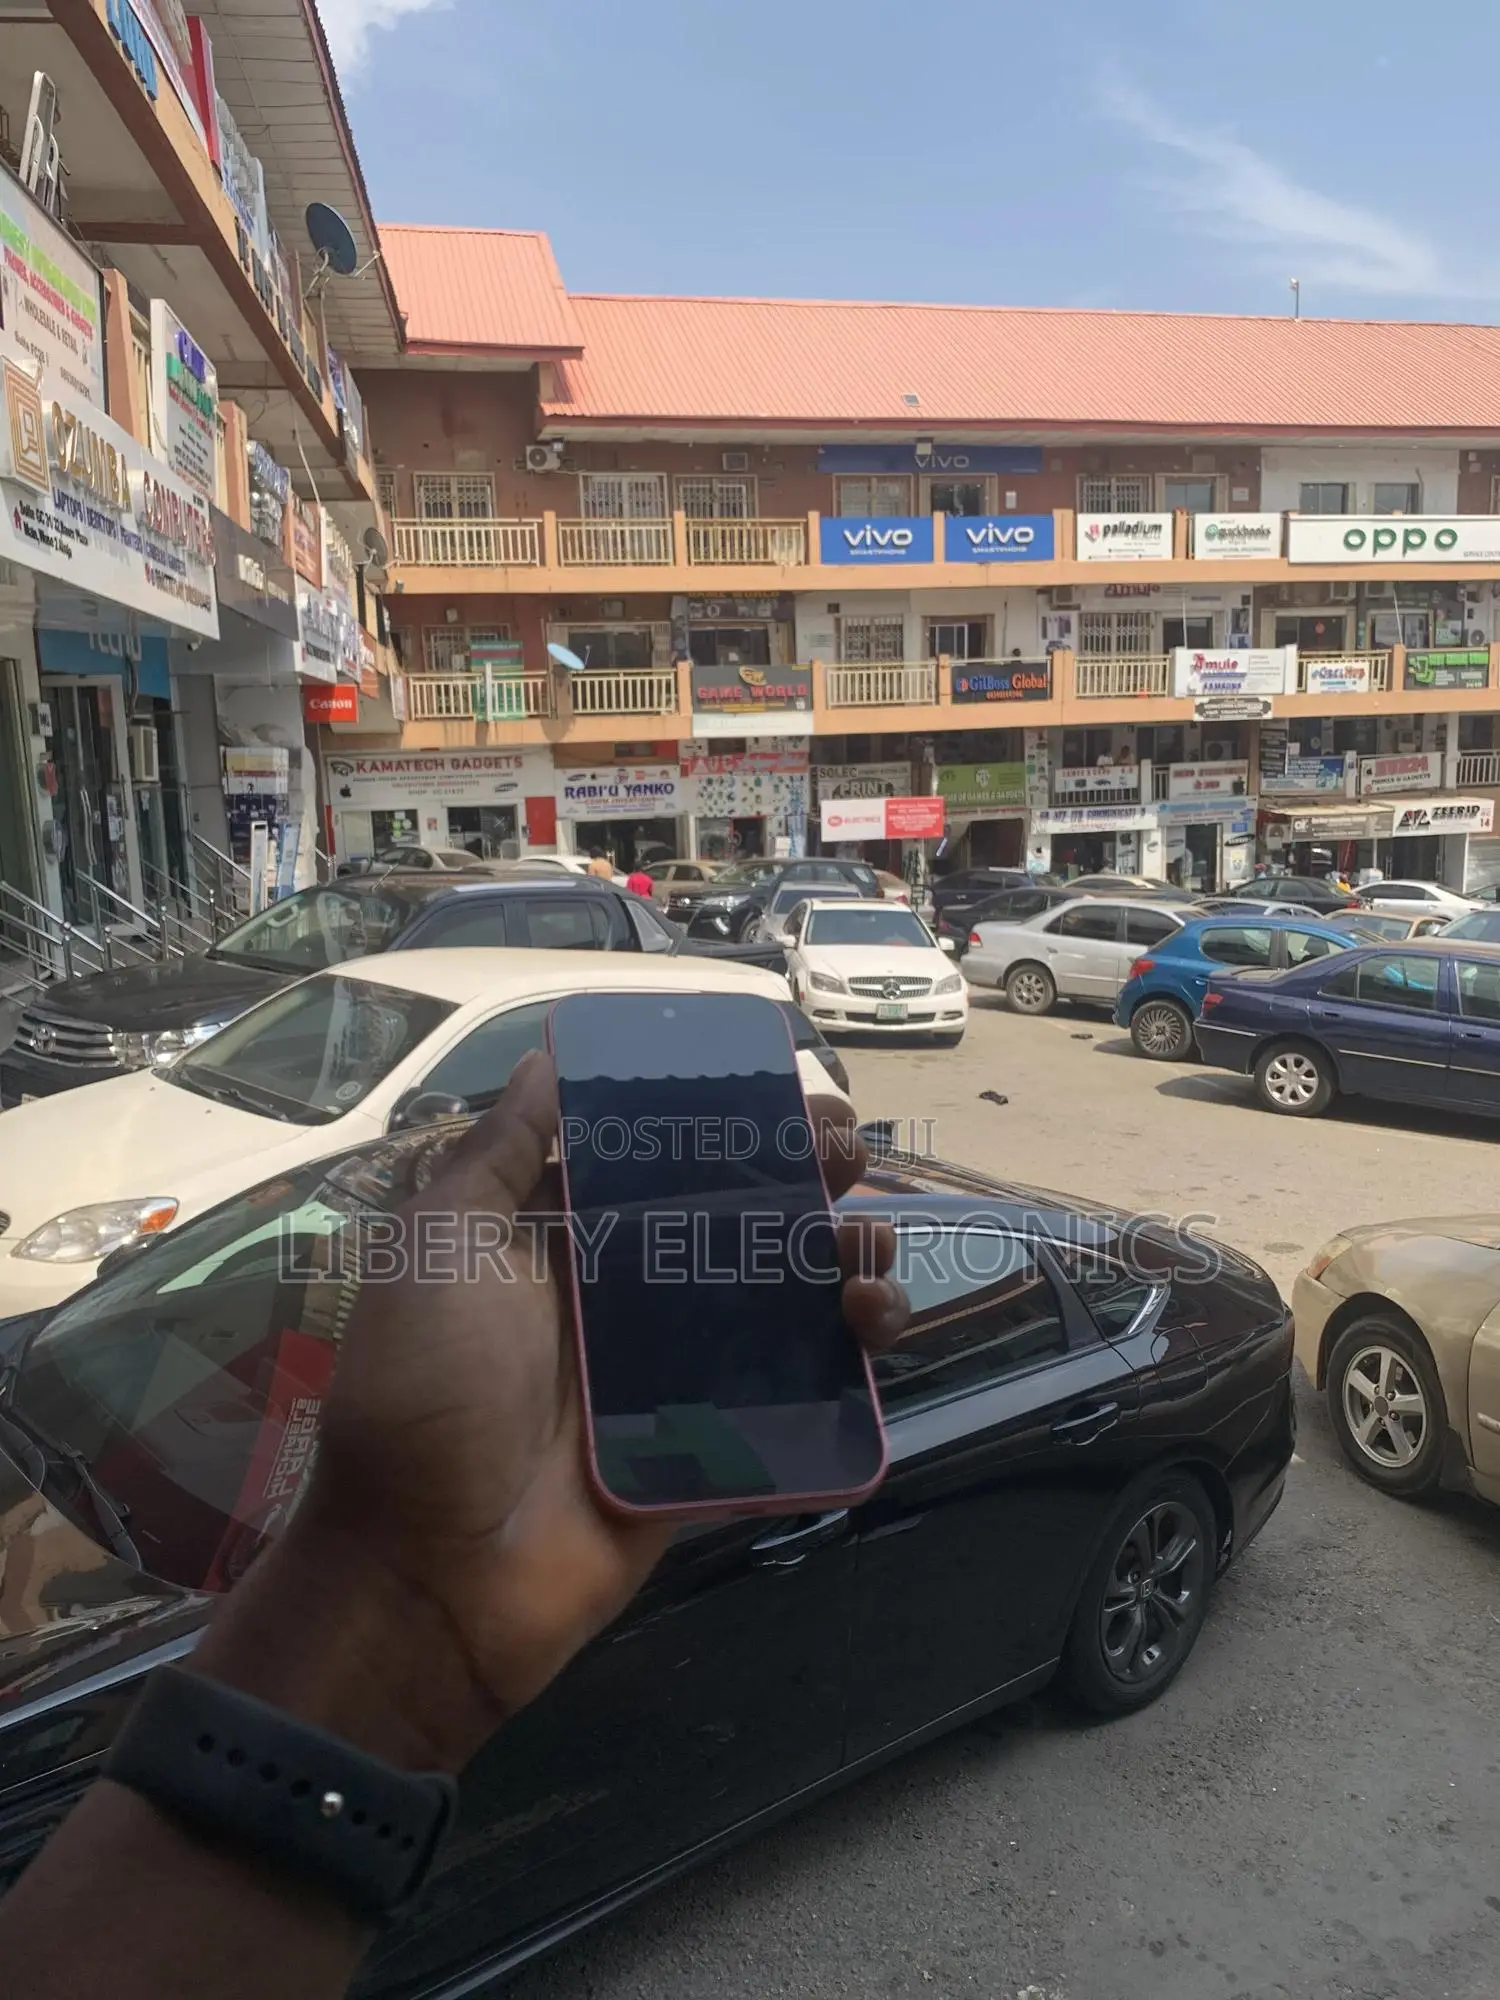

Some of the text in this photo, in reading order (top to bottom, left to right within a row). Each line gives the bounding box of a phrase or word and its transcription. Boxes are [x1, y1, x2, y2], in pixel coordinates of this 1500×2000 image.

[24, 294, 56, 338] WHOLESALE
[51, 401, 132, 514] OZUMBA
[52, 486, 83, 523] LAPTOPS
[143, 471, 216, 567] COMPUTERS
[1103, 520, 1163, 538] palladium
[843, 523, 914, 547] vivo
[966, 521, 1035, 546] vivo
[1343, 528, 1458, 557] oppo
[697, 683, 808, 699] GAME WORLD
[1011, 672, 1048, 689] Global
[309, 698, 353, 711] Canon
[356, 755, 524, 774] KAMATECH GADGETS
[564, 782, 675, 799] RABI'U YANKO
